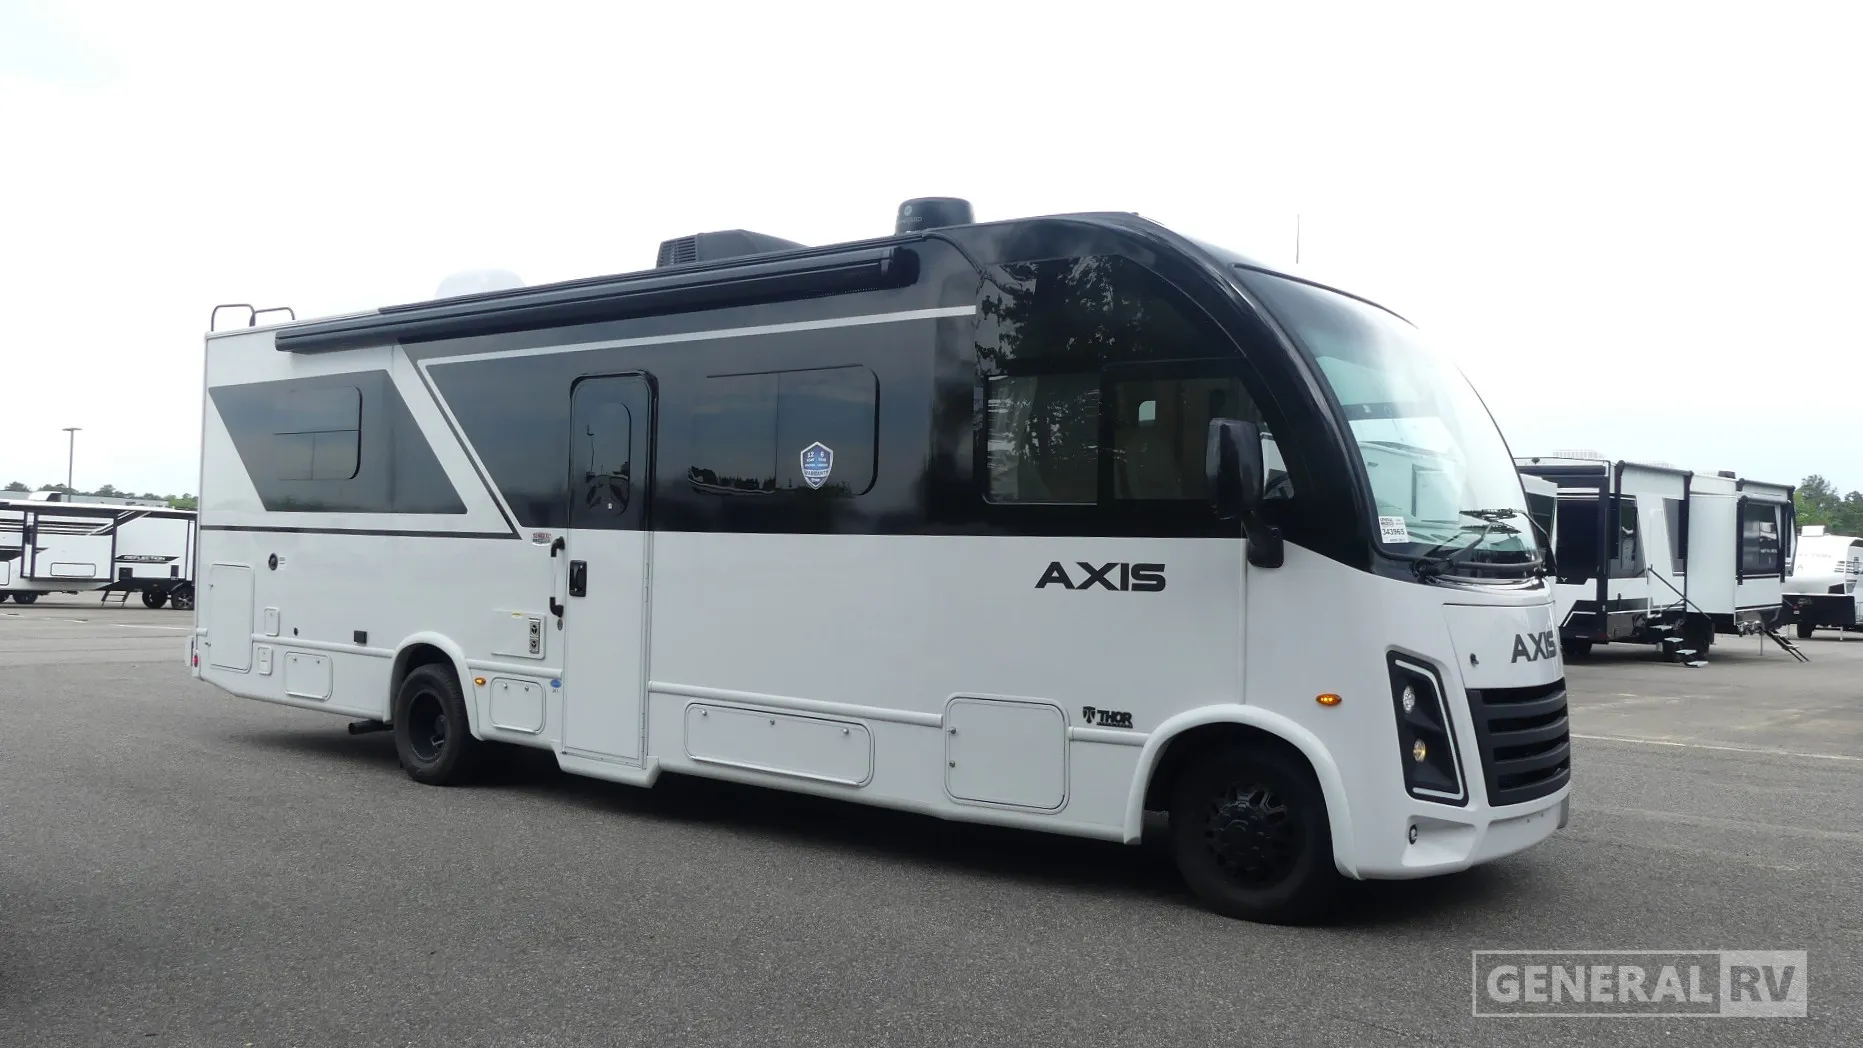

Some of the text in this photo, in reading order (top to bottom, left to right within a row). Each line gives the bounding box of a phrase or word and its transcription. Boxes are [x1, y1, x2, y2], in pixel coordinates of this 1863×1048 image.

[1034, 561, 1167, 592] AXIS
[1510, 630, 1557, 664] AXIS
[1096, 709, 1133, 728] THOR
